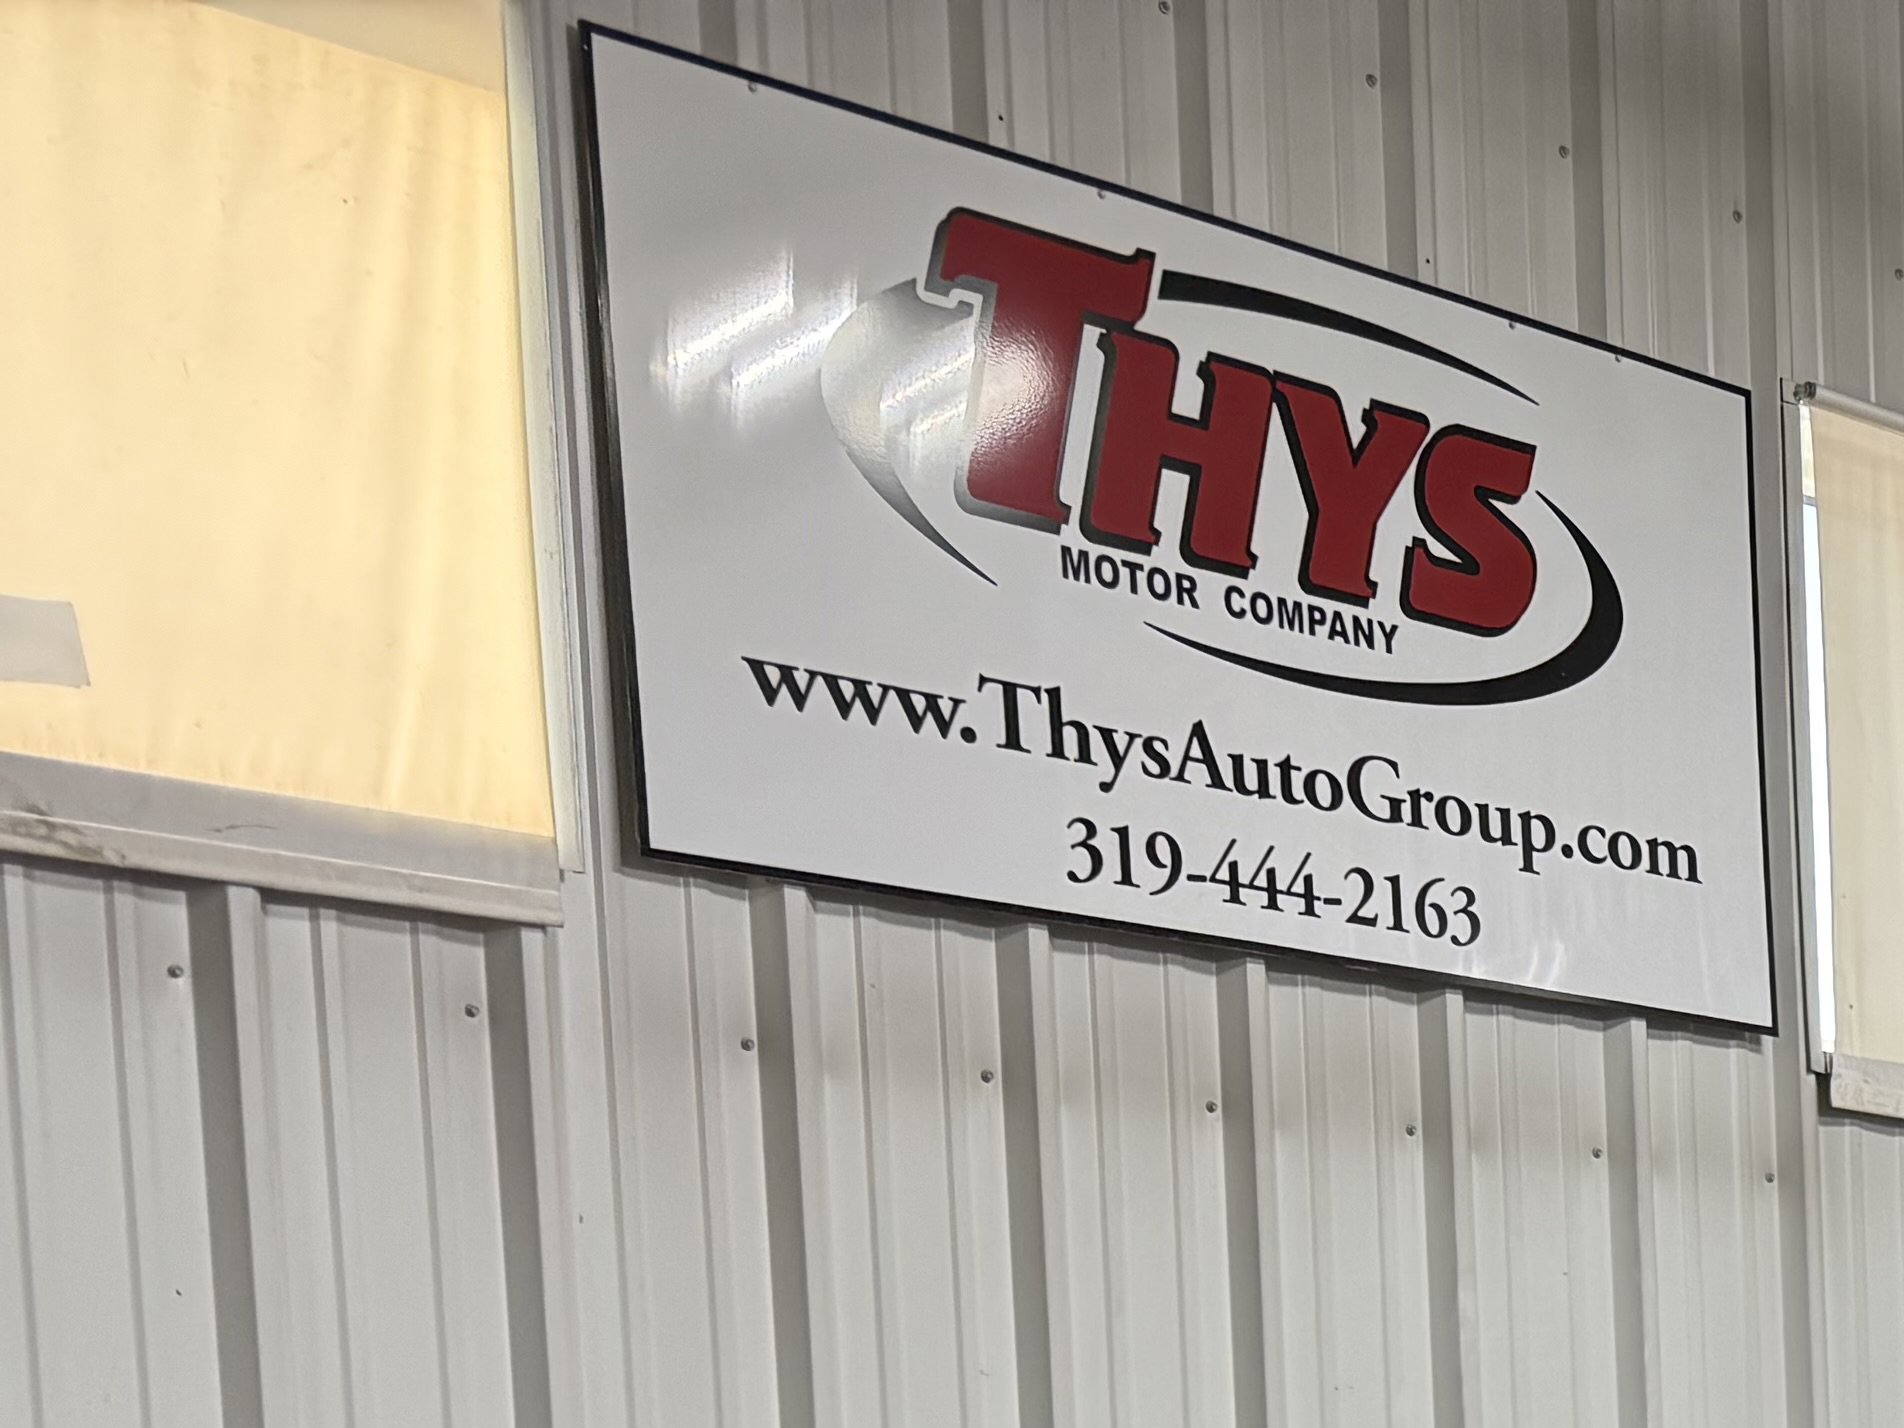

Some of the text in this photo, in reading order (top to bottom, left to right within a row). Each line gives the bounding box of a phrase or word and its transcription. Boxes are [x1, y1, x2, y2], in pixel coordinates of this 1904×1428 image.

[921, 206, 1538, 638] THYS
[1060, 543, 1400, 654] MOTOR COMPANY
[741, 655, 1704, 884] www.ThysAutoGroup.com
[1065, 815, 1483, 948] 319-444-2163
